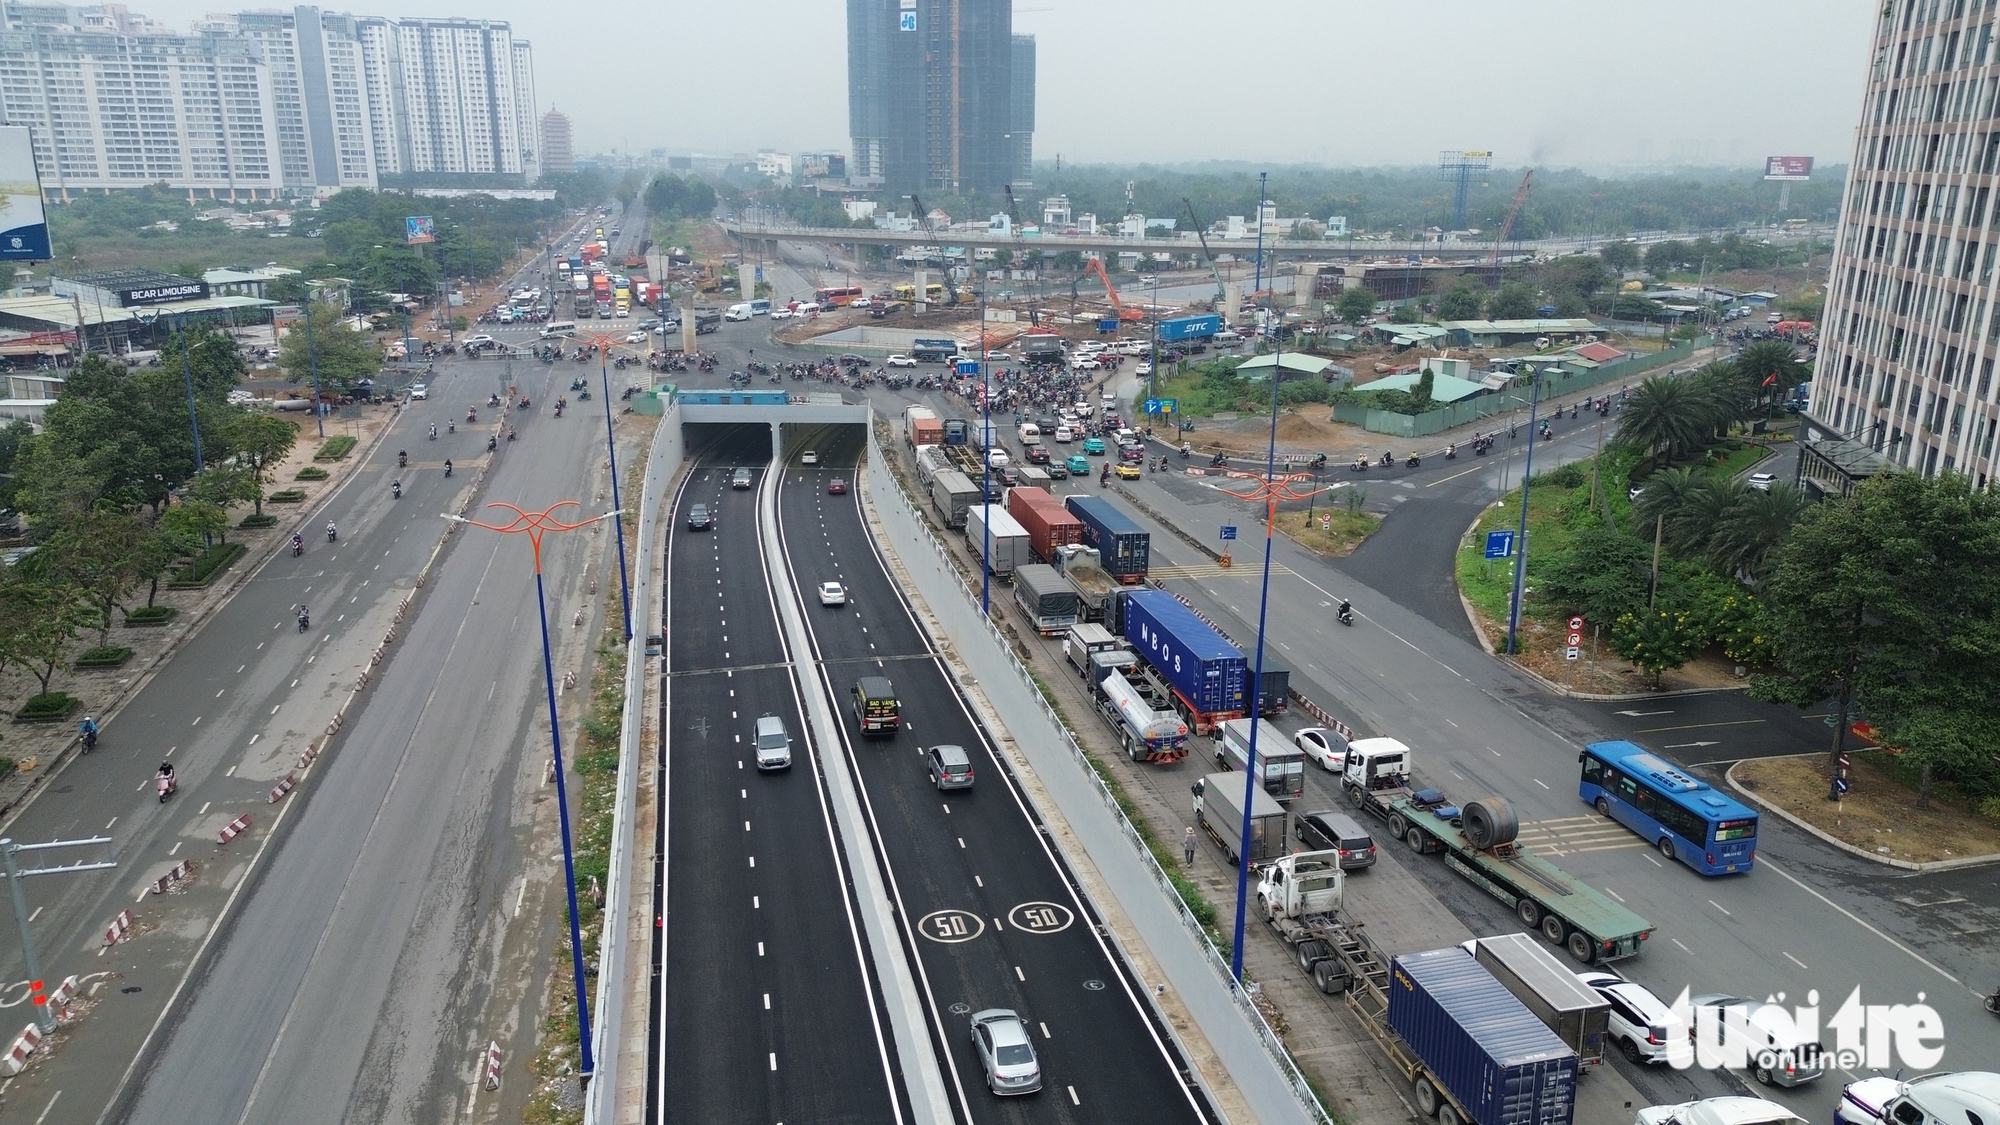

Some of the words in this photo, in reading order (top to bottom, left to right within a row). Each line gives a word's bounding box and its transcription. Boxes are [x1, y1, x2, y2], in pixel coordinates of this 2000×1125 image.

[131, 289, 157, 300] BCAR
[157, 285, 201, 297] LIMOUSINE
[1184, 322, 1208, 333] SITC
[1141, 622, 1181, 673] NBOS
[934, 916, 968, 937] 50
[1024, 908, 1060, 928] 50
